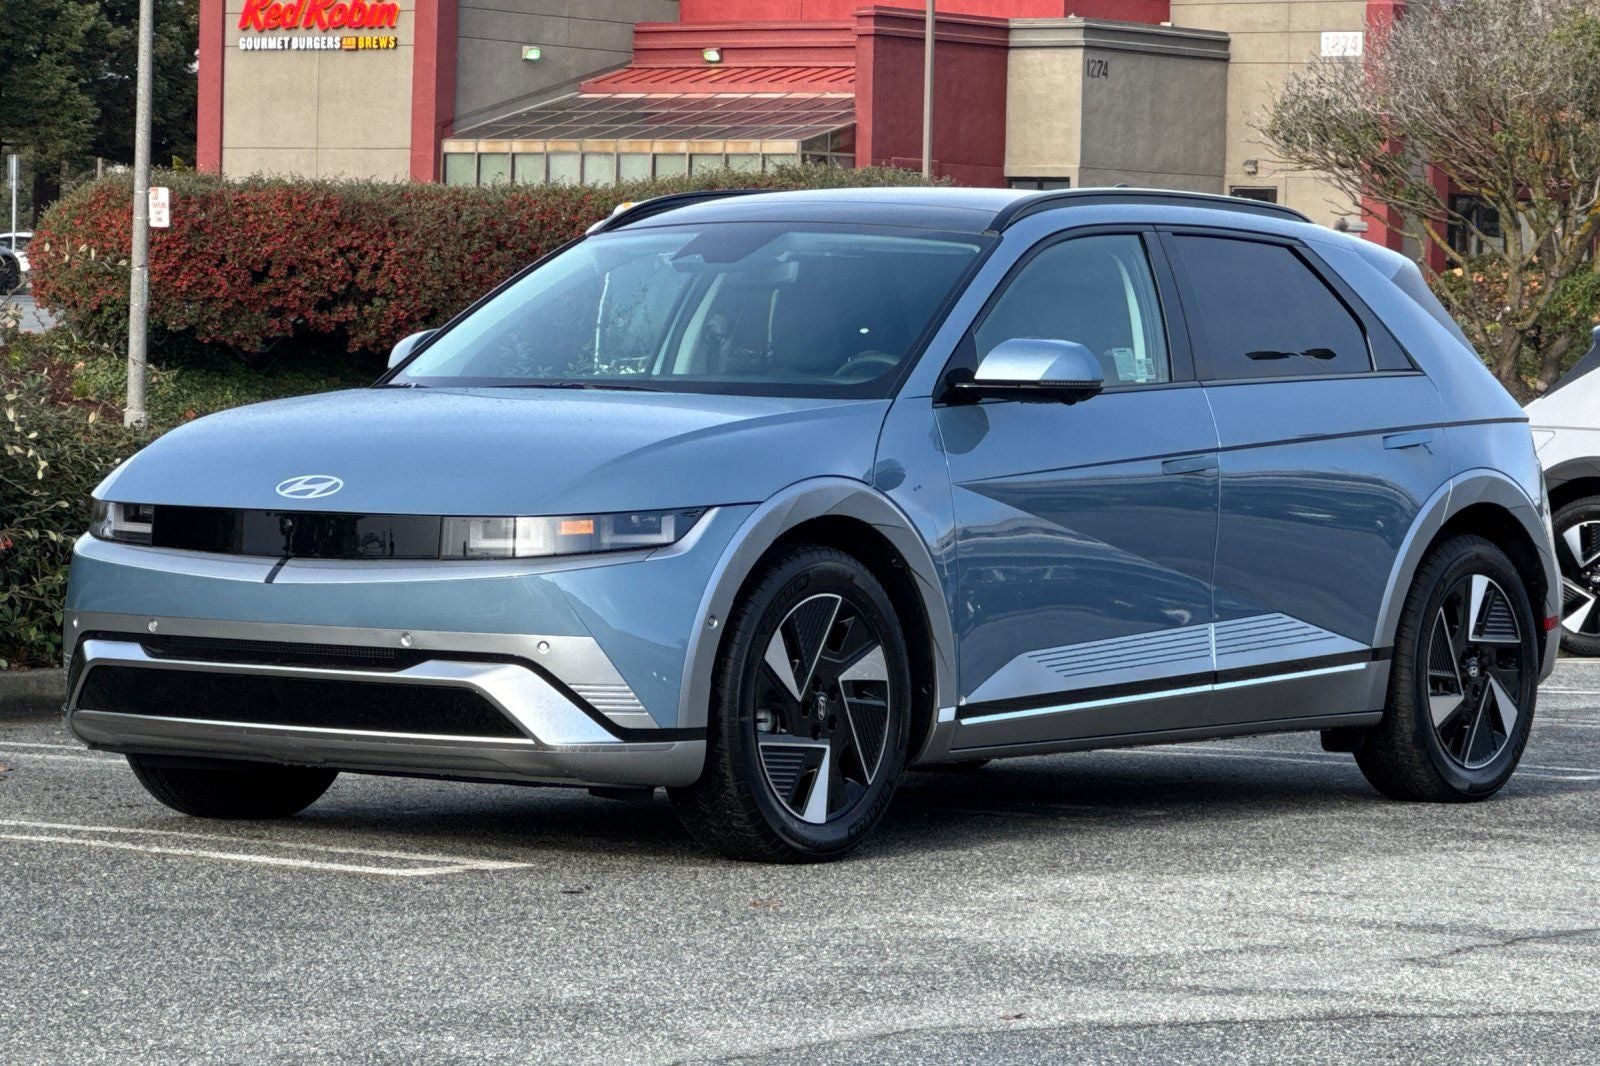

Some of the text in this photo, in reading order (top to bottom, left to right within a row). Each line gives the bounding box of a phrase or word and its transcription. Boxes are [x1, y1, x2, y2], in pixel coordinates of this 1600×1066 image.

[238, 0, 399, 32] Red Robin
[239, 36, 396, 50] GOURMET BURGERS AND BREWS
[1087, 58, 1109, 79] 1274
